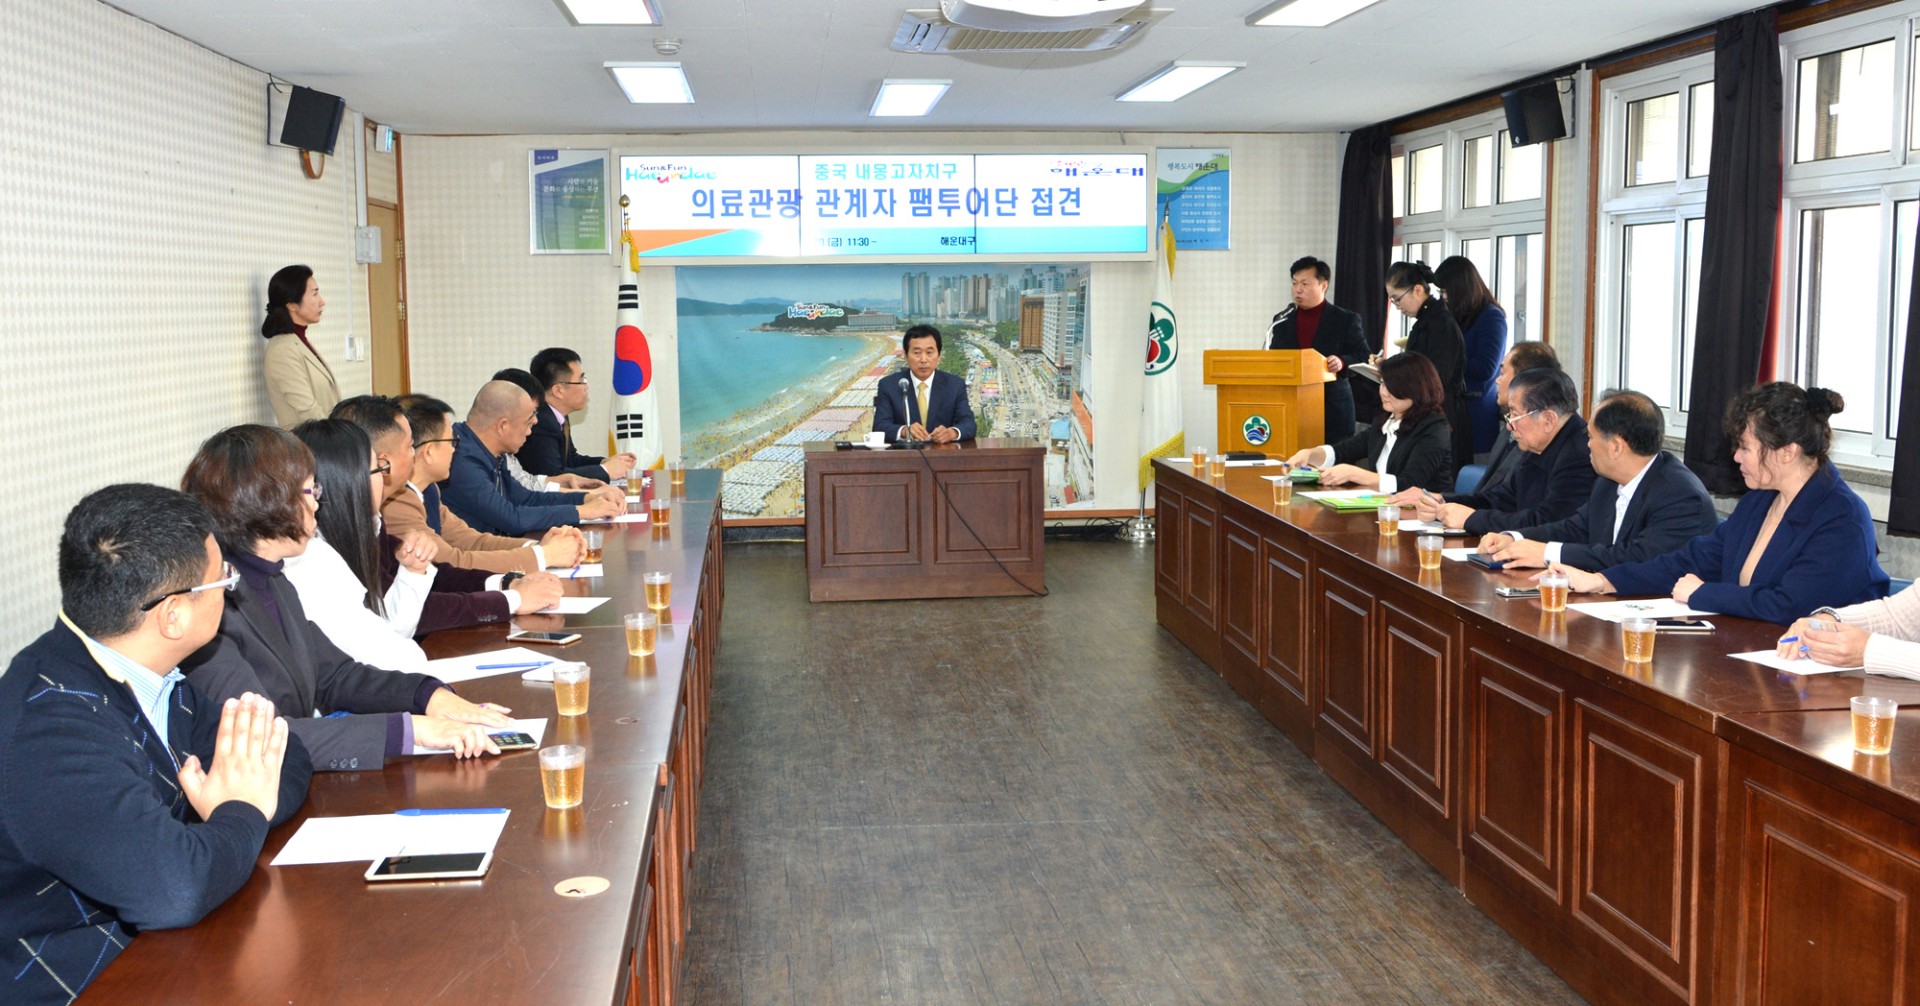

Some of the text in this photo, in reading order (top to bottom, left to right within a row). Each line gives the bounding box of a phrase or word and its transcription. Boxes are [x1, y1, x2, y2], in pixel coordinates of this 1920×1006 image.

[815, 163, 958, 181] 중국 내몽고자치구
[1167, 162, 1219, 171] 행복도시 해운대
[691, 187, 1080, 219] 의료관광 관계자 팸투어단 접견
[940, 236, 977, 246] 해운대구
